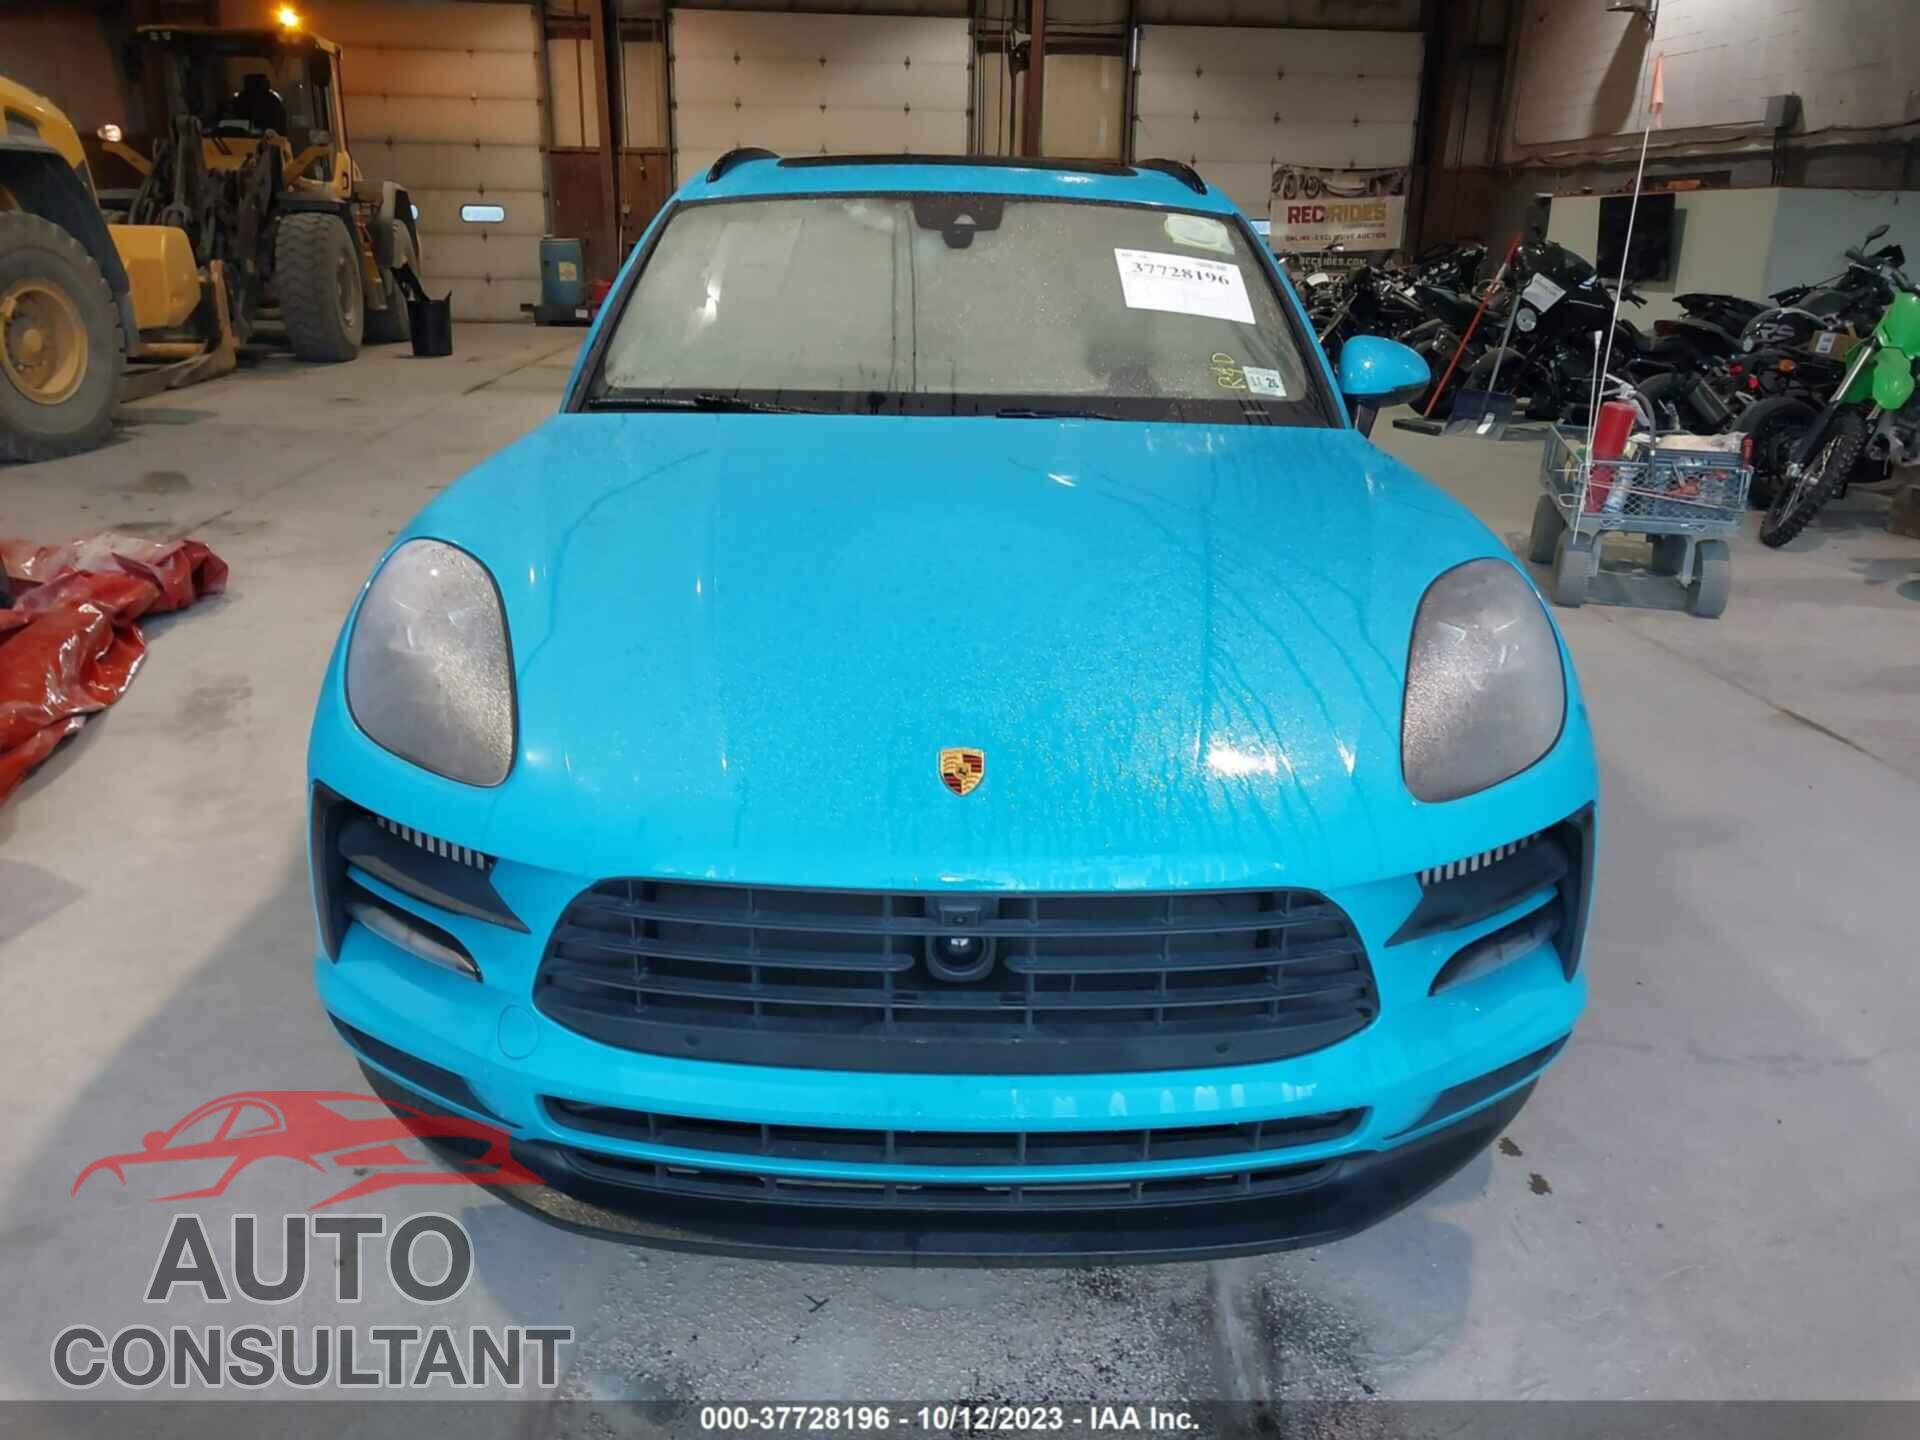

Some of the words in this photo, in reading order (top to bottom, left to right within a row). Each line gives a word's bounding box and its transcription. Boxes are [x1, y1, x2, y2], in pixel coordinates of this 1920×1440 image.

[1287, 203, 1386, 224] RECRIDES
[1357, 232, 1387, 241] AUCTION
[1130, 261, 1230, 285] 37728196
